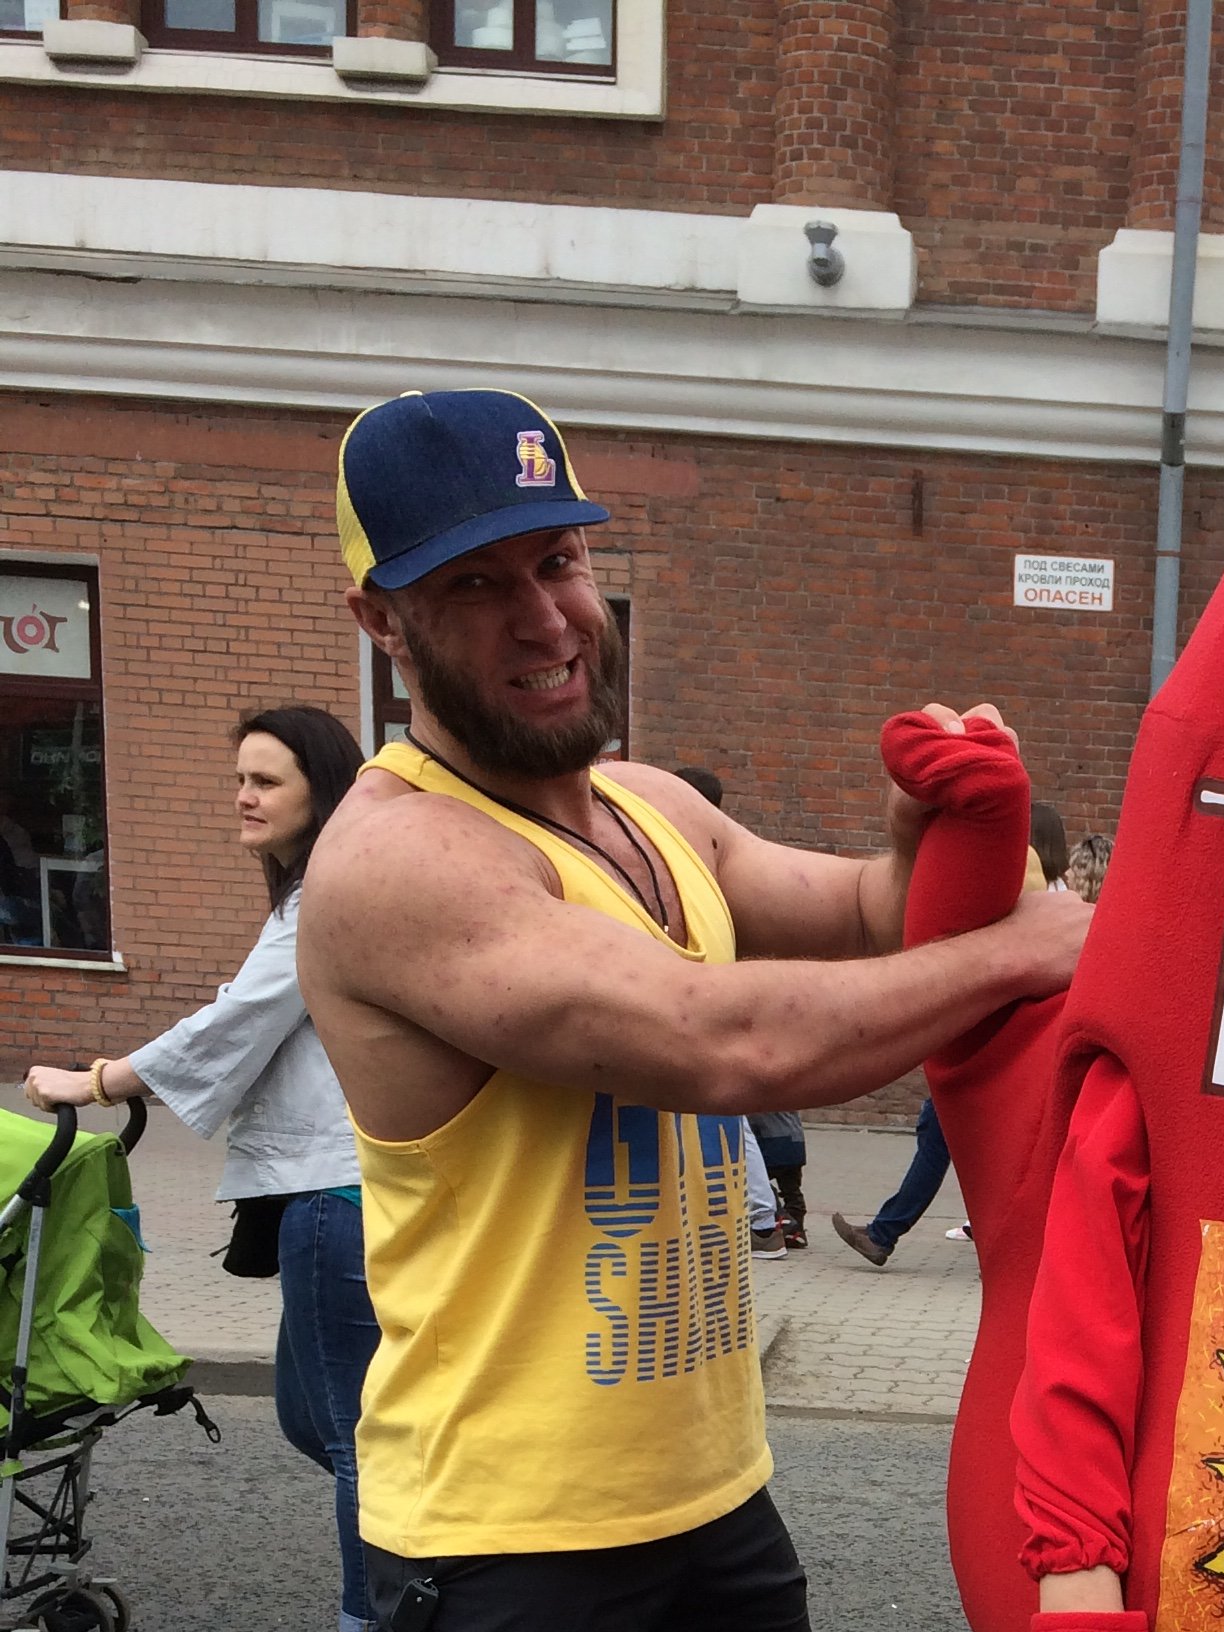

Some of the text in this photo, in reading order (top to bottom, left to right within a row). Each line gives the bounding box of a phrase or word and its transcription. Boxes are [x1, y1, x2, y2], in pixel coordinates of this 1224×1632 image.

[1024, 559, 1104, 574] ПОД СВЕСАМИ
[1018, 573, 1110, 590] КРОВЛИ ПРОХОД
[1024, 588, 1103, 605] ОПАСЕН
